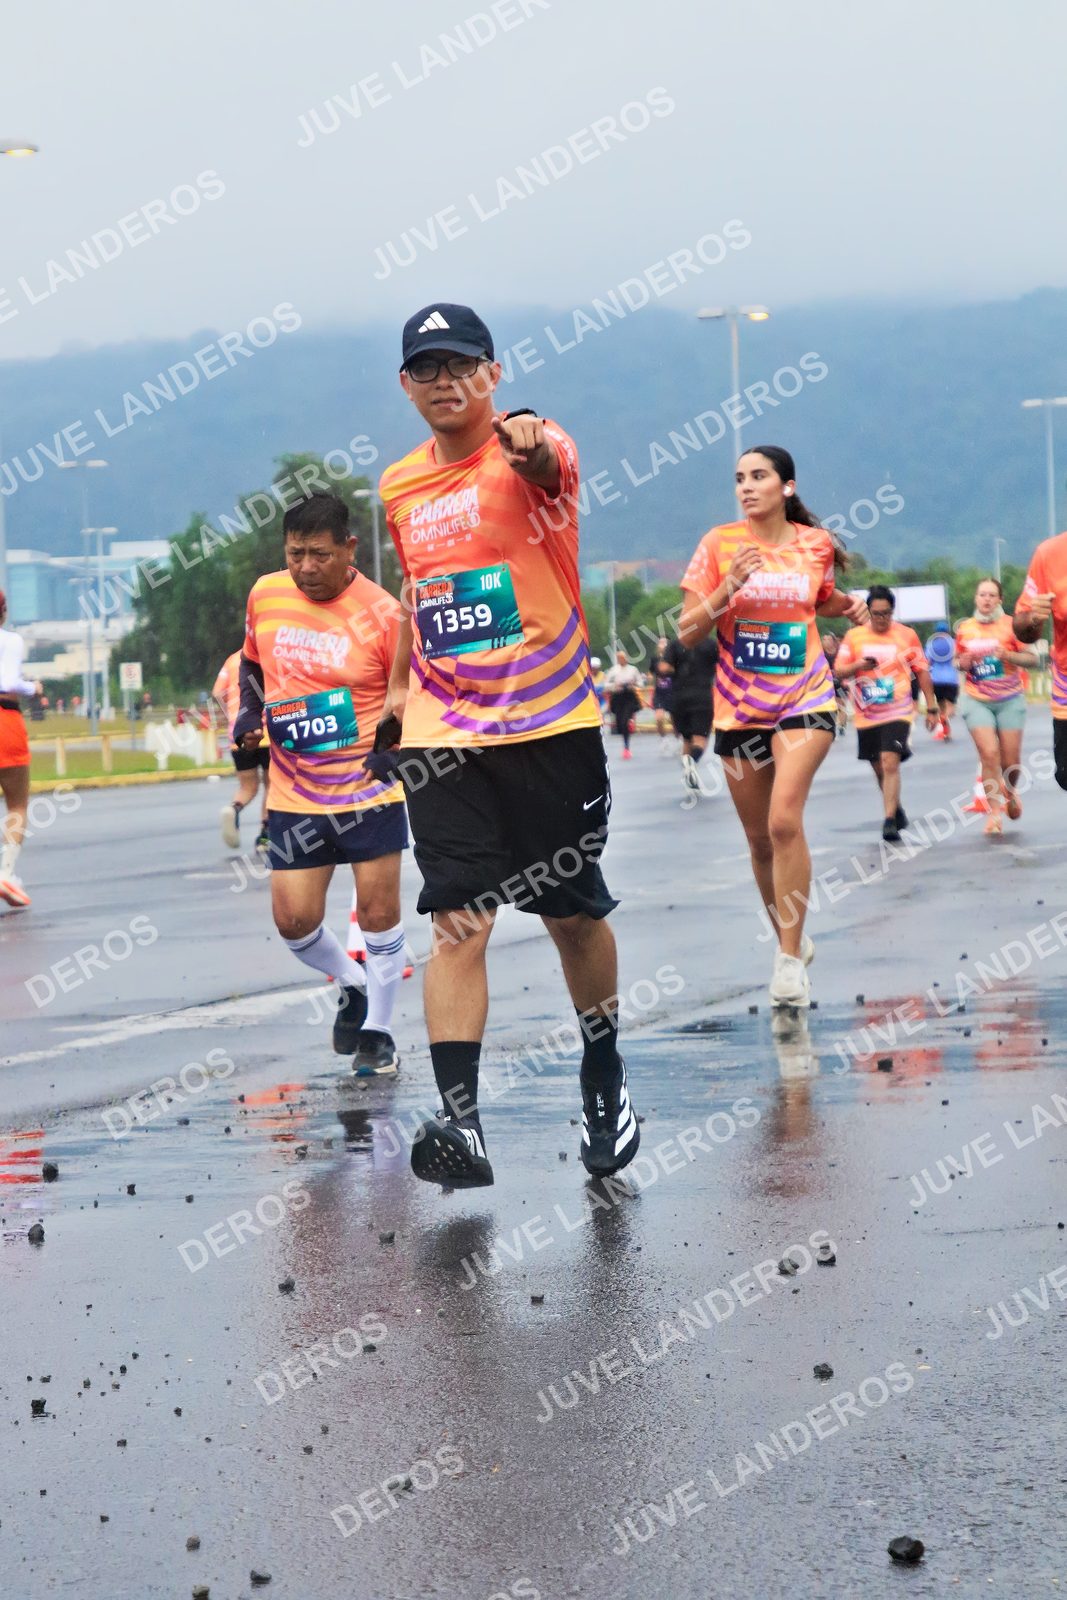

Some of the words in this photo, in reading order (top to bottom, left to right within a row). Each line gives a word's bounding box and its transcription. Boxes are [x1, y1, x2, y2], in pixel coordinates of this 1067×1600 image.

[410, 484, 479, 526] CARRERA
[411, 515, 467, 544] OMNILIFE
[419, 581, 453, 599] CARRERA
[480, 572, 502, 591] 10K
[432, 603, 493, 635] 1359
[275, 625, 349, 656] CARRERA
[745, 641, 791, 660] 1190
[271, 701, 307, 717] CARRERA
[286, 715, 338, 740] 1703
